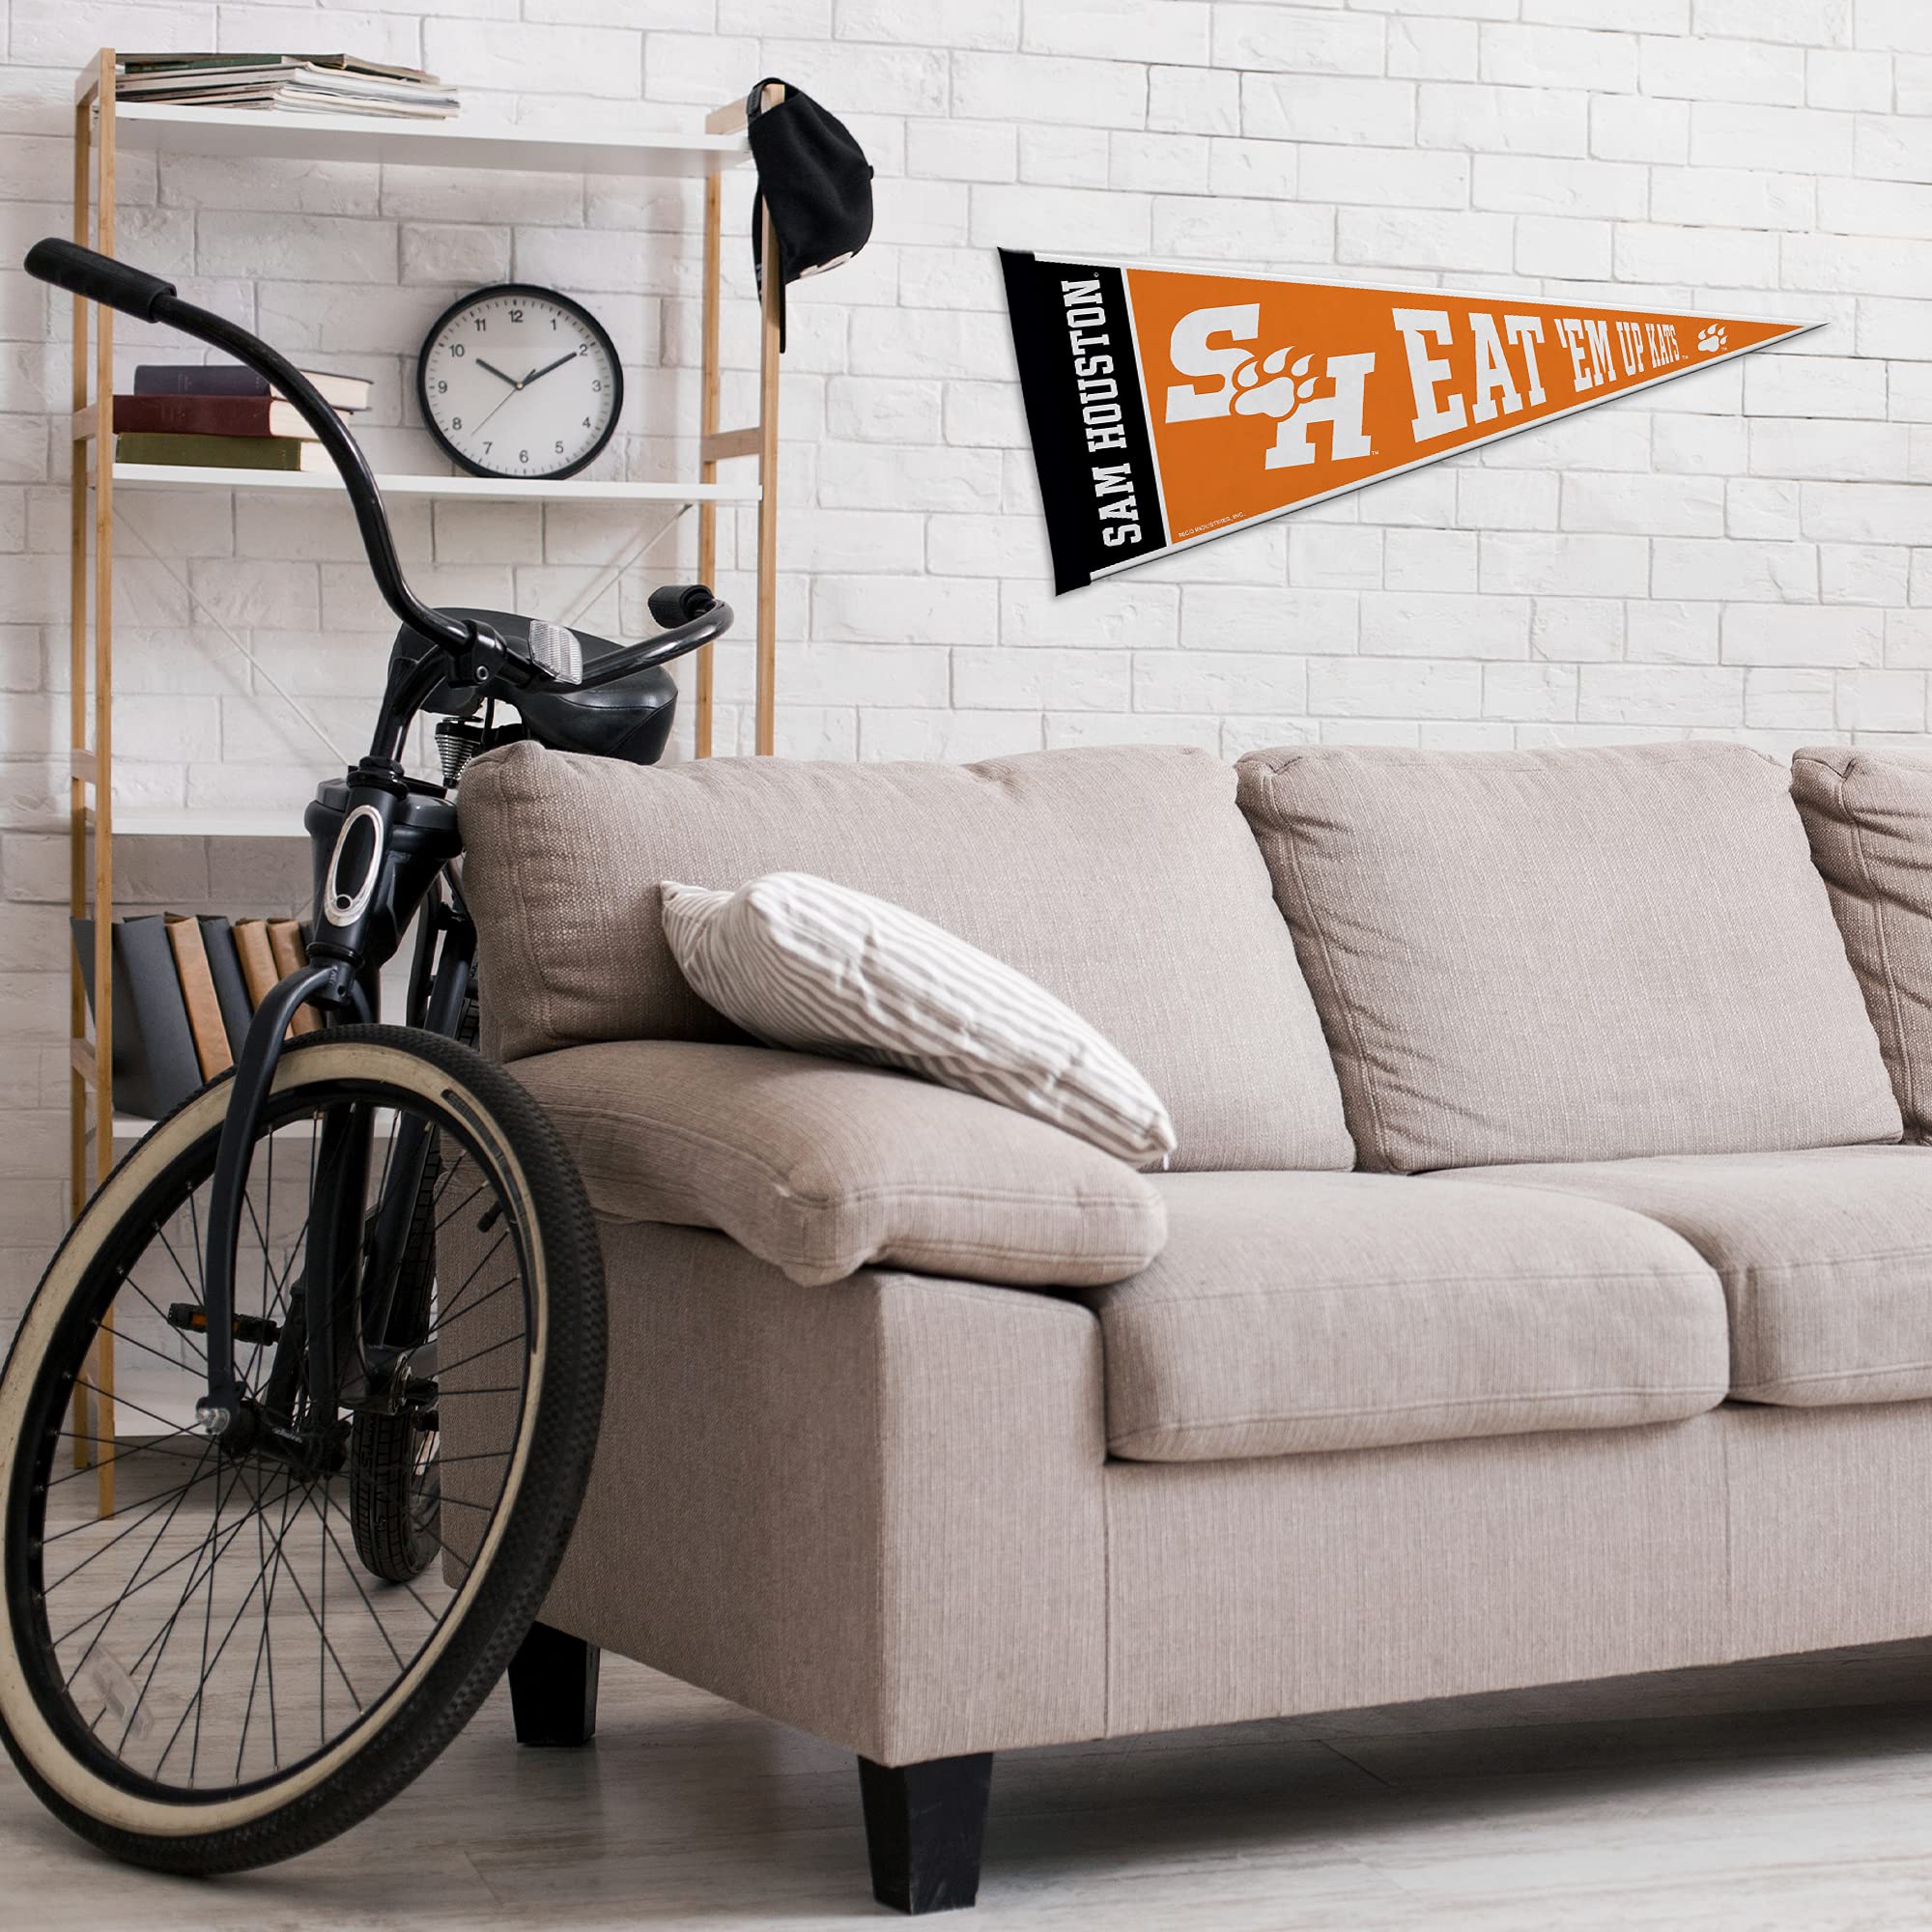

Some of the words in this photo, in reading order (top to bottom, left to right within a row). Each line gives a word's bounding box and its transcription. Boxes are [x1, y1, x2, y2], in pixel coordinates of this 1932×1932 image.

[508, 309, 524, 324] 12
[474, 319, 487, 332] 11
[550, 319, 556, 330] 1
[449, 344, 465, 357] 10
[579, 344, 588, 356] 2
[1062, 279, 1127, 453] HOUSTON
[1392, 307, 1547, 442] EAT
[1553, 318, 1617, 392] 'EM
[1615, 321, 1644, 376] UP
[1645, 323, 1681, 370] KATS
[438, 380, 447, 393] 9
[591, 380, 602, 392] 3
[452, 417, 462, 430] 8
[582, 416, 591, 429] 4
[483, 441, 493, 455] 7
[554, 440, 564, 454] 5
[519, 450, 528, 463] 6
[1092, 463, 1143, 548] SAM
